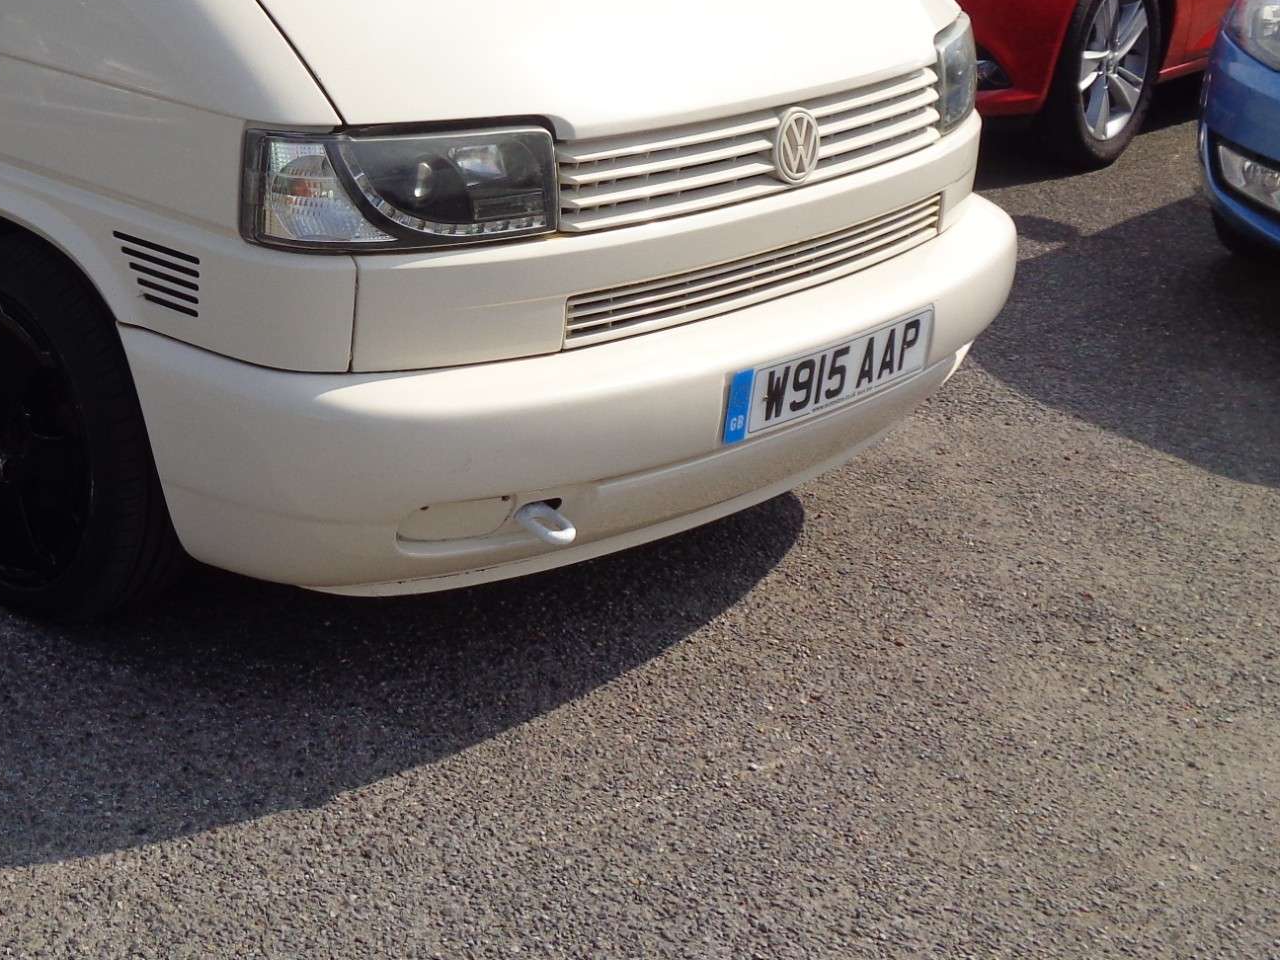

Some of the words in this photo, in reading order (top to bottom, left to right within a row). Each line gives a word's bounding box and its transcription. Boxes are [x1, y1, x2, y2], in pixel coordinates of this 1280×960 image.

[765, 345, 850, 422] W915
[856, 319, 921, 388] AAP
[730, 414, 744, 432] GB
